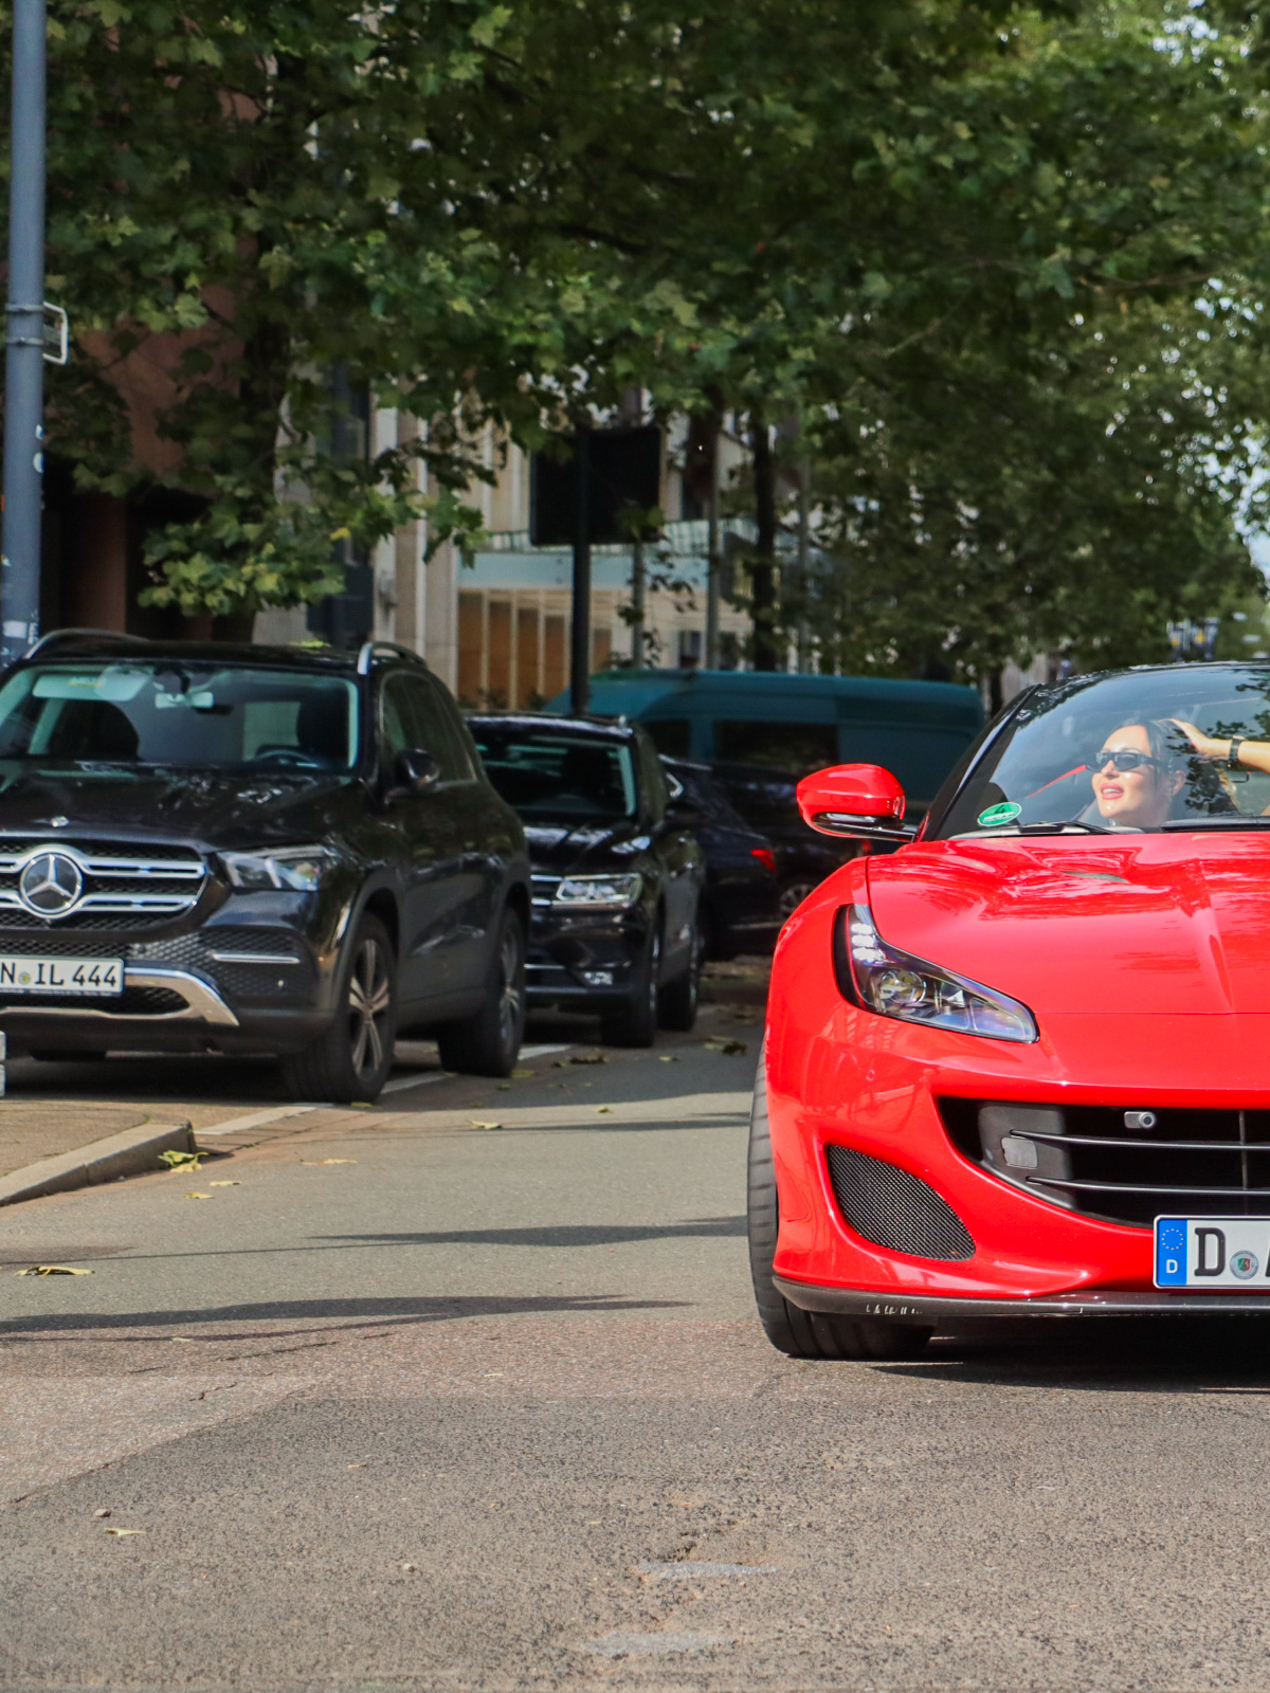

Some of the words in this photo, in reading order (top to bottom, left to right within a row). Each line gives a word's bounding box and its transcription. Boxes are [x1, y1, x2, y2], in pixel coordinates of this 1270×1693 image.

[35, 963, 64, 986] IL
[72, 965, 117, 987] 444
[1194, 1227, 1226, 1277] D
[1166, 1259, 1178, 1274] D
